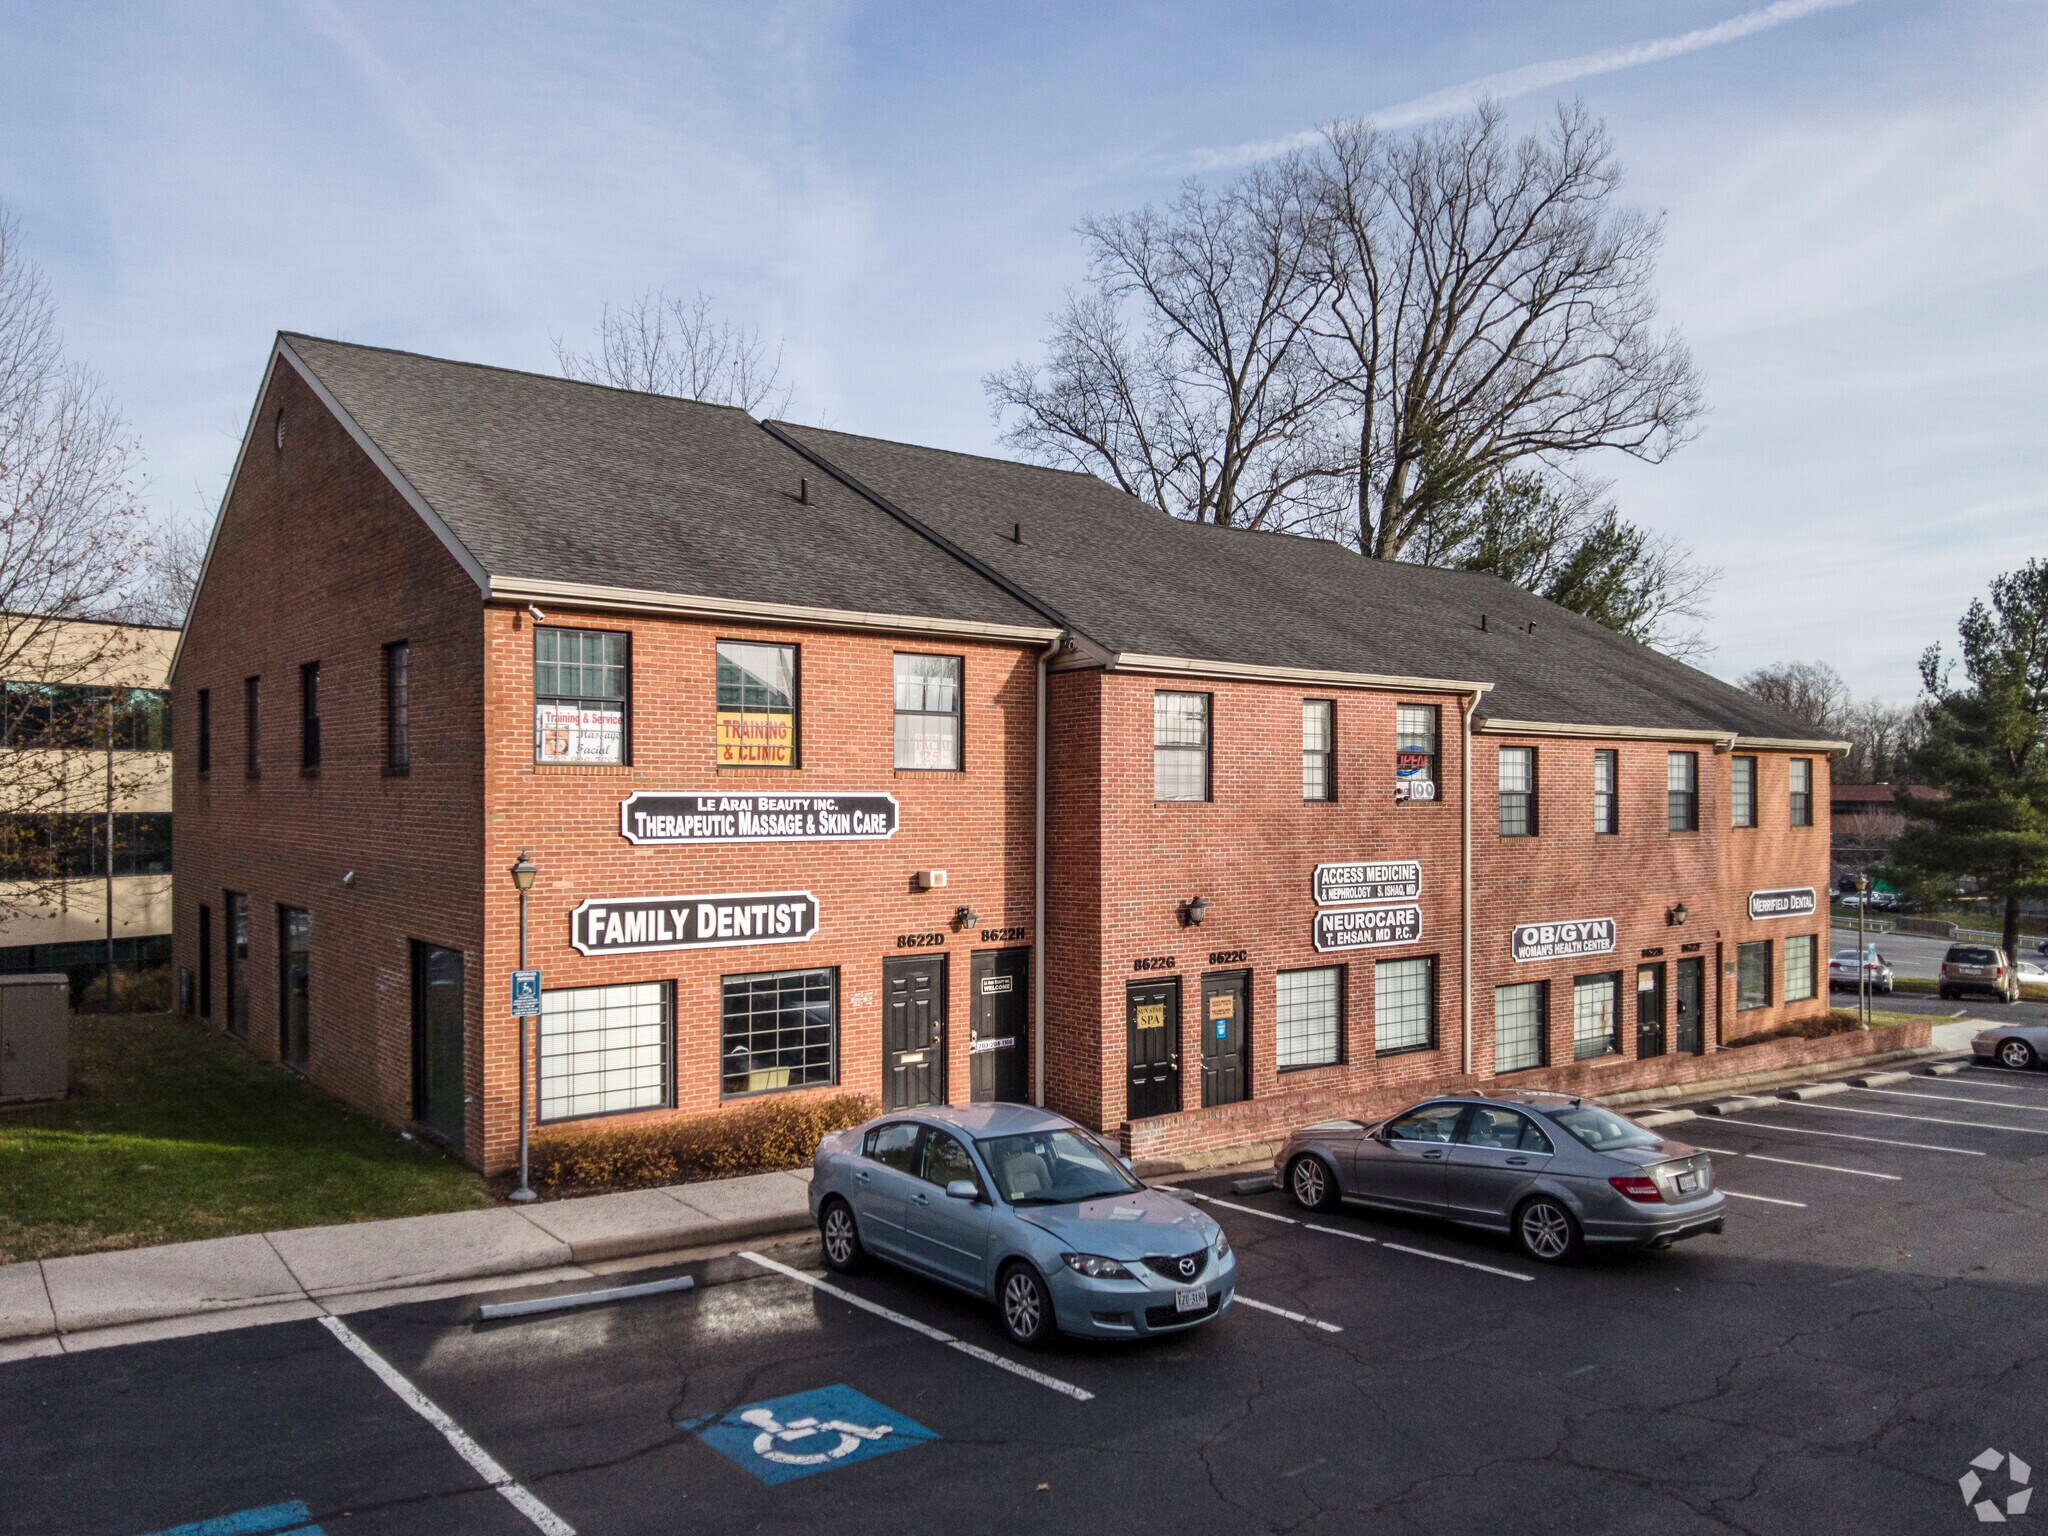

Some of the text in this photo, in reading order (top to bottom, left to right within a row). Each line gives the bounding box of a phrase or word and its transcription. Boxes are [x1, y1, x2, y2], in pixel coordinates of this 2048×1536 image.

[545, 711, 623, 726] Training & Service
[576, 729, 622, 743] Masage
[723, 719, 787, 740] TRAINING
[723, 743, 785, 762] & CLINIC
[697, 797, 839, 811] LE ARAI BEAUTY INC.
[634, 810, 887, 837] THERAPEUTIC MASSAGE & SKIN CARE
[1321, 865, 1416, 885] ACCESS MEDICINE
[1328, 886, 1372, 900] NEPHROLOGY
[1753, 895, 1814, 912] MERRIFIELD DENTAL
[588, 903, 807, 945] FAMILY DENTIST
[1322, 909, 1415, 931] NEUROCARE
[897, 933, 945, 948] 8622D
[981, 927, 1025, 942] 8622H
[1325, 926, 1413, 946] T. EHSAN, MD P.C.
[1522, 922, 1608, 945] OB/GYN
[1518, 939, 1610, 958] WOMAN'S HEALTH CENTER
[1133, 956, 1176, 971] 8622G
[1208, 950, 1247, 965] 8622C
[1141, 1016, 1160, 1025] SPA
